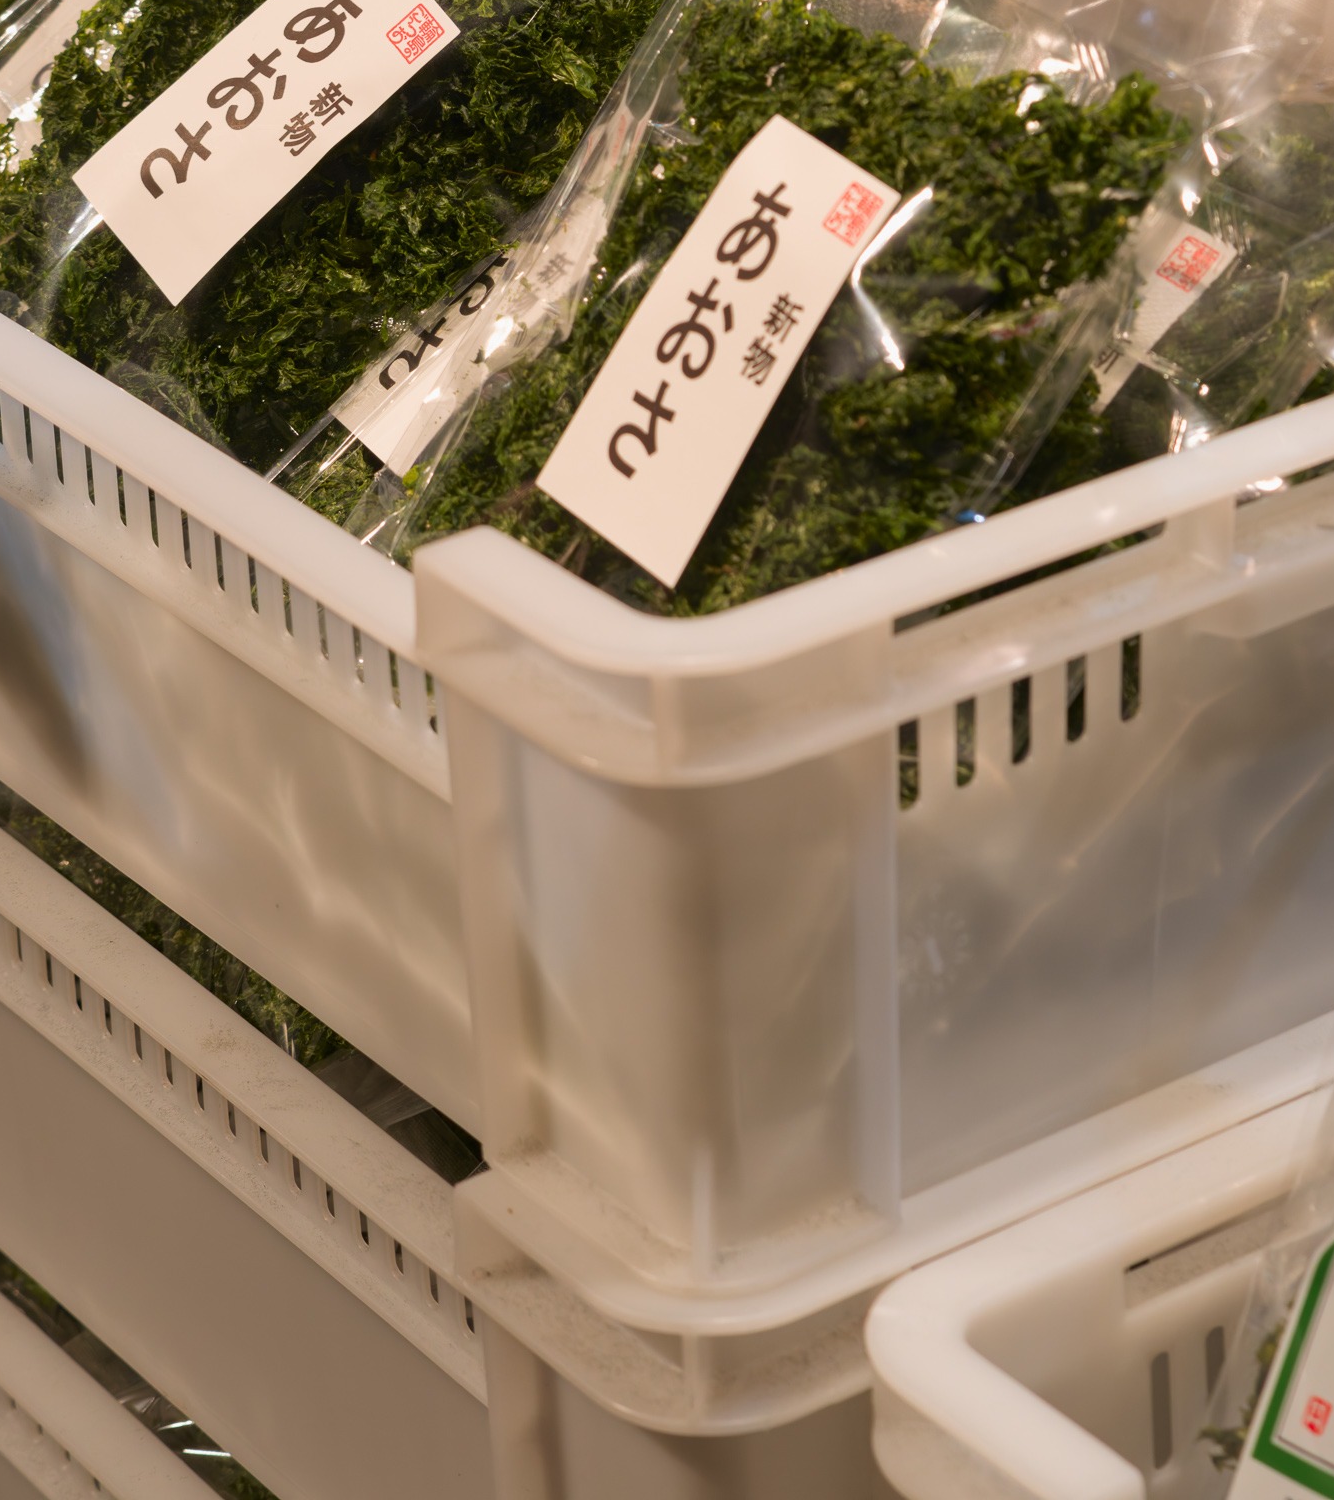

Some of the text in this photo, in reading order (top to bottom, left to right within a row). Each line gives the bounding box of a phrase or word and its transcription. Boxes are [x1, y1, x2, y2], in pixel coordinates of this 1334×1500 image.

[279, 81, 355, 157] 新物
[607, 181, 792, 479] あおさ
[740, 292, 805, 386] 新物
